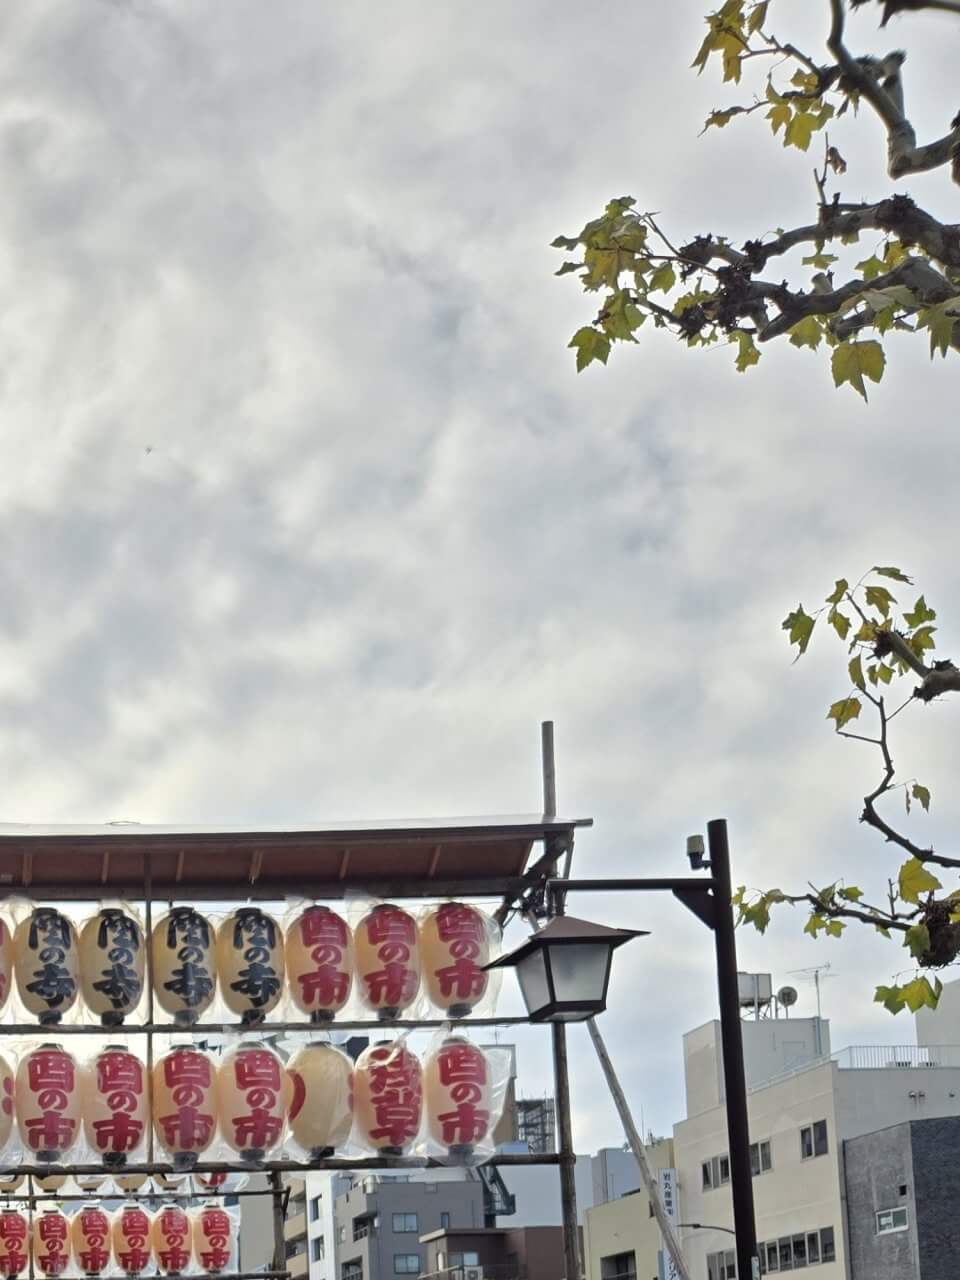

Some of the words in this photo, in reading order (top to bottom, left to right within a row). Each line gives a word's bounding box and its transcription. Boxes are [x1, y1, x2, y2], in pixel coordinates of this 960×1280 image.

[297, 908, 350, 1006] 酉の市
[364, 907, 417, 1006] 酉の市
[434, 904, 488, 999] 酉の市
[24, 1052, 77, 1150] 酉の市
[93, 1052, 145, 1151] 酉の市
[159, 1050, 214, 1149] 酉の市
[231, 1050, 284, 1149] 酉の市
[437, 1044, 490, 1145] 酉の市
[38, 1214, 72, 1276] 酉の市
[79, 1210, 111, 1273] 酉の市
[118, 1210, 151, 1273] 酉の市
[159, 1210, 191, 1273] 酉の市
[200, 1209, 231, 1272] 酉の市
